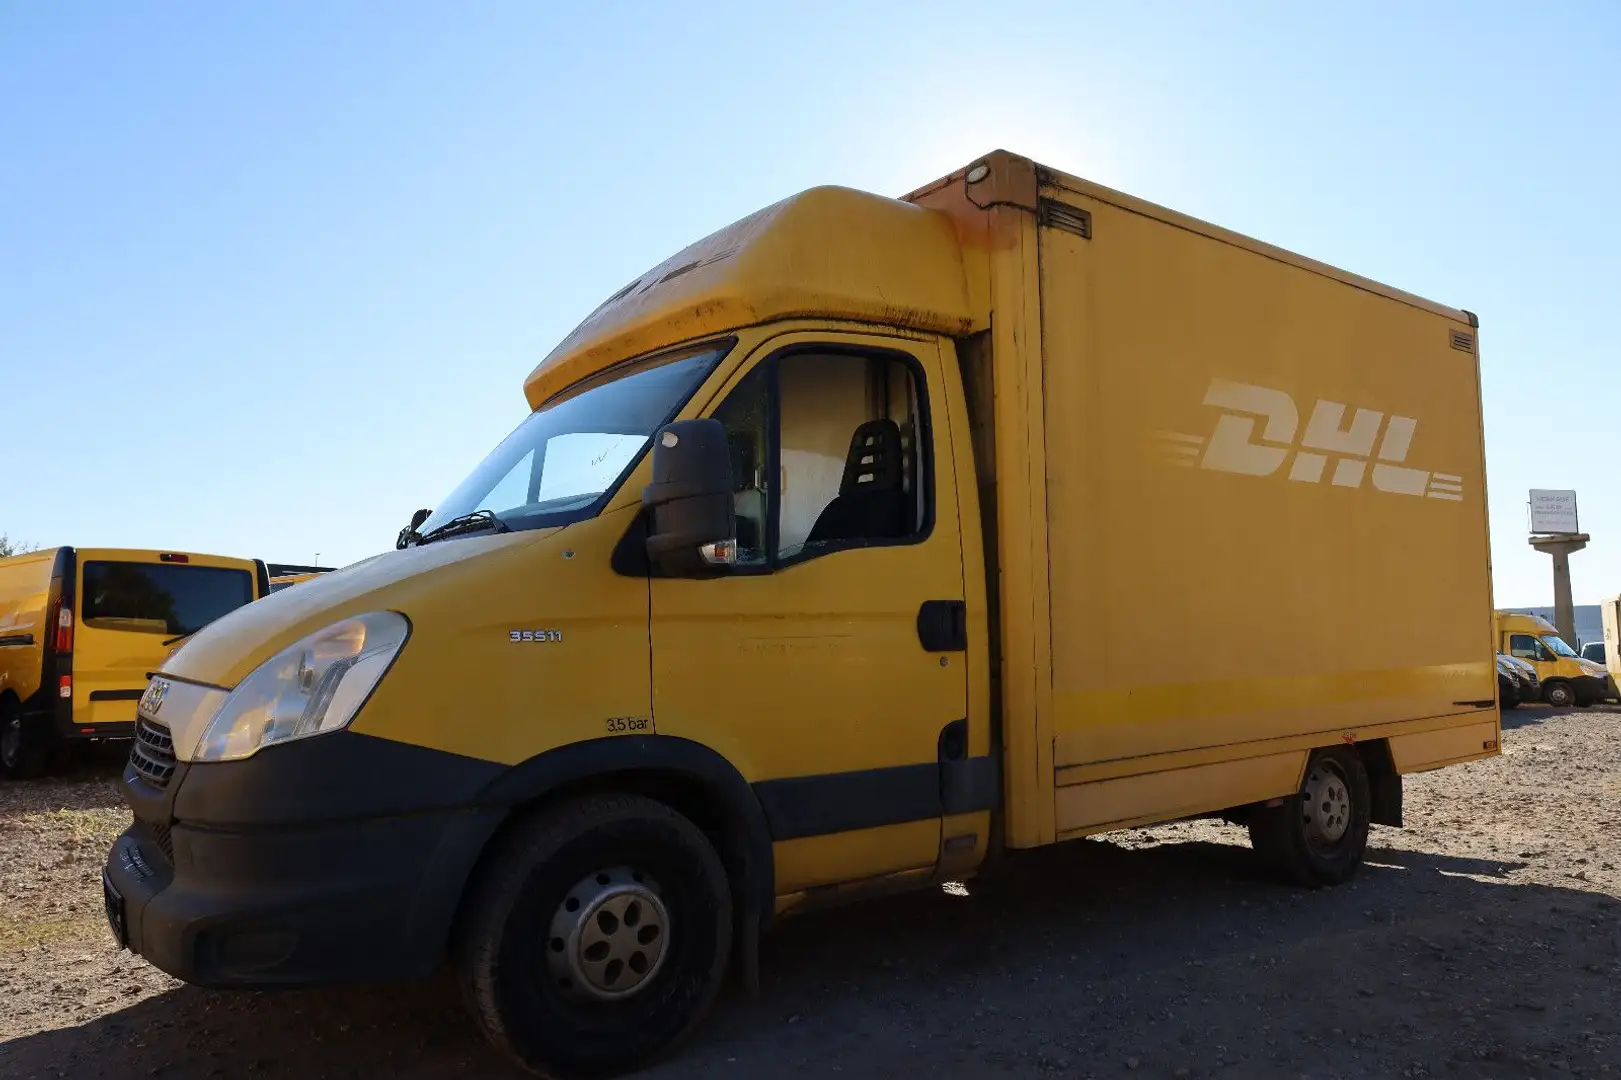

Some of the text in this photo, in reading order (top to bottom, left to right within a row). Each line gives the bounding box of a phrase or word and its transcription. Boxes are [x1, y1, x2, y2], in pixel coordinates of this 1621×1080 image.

[1201, 379, 1430, 496] DHL
[509, 629, 563, 643] 35S11
[628, 717, 649, 731] bar
